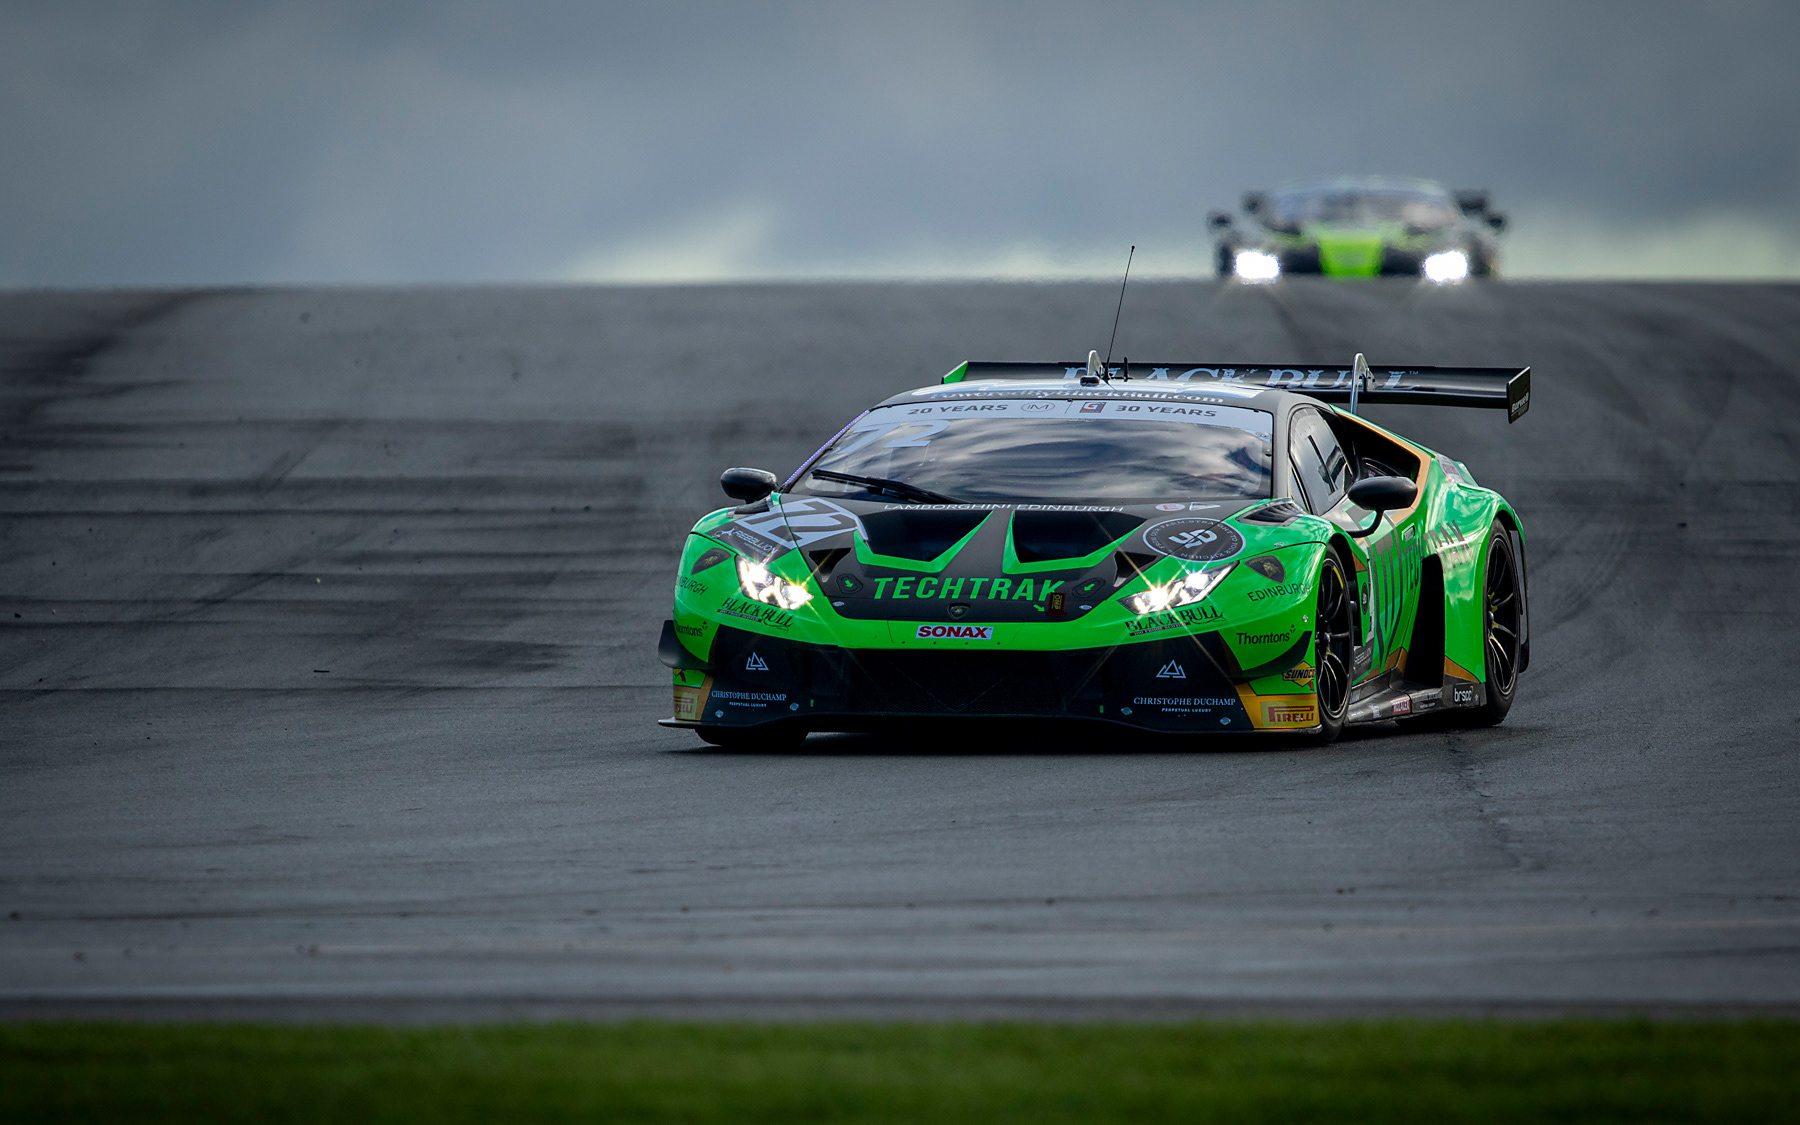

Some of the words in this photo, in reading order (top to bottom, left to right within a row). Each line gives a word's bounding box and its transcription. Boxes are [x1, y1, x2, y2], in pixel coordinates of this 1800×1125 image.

[907, 407, 933, 415] 20
[940, 404, 1008, 414] YEARS
[1147, 406, 1217, 417] YEARS
[836, 420, 951, 455] 72
[883, 503, 1011, 511] LAMBORGHINI
[1016, 503, 1125, 512] EDINBURGH
[874, 577, 1065, 601] TECHTRAK
[1247, 582, 1312, 602] EDINBURGH
[722, 597, 760, 617] BLACK
[761, 607, 794, 628] BULL
[1125, 612, 1180, 631] BLACK
[1179, 605, 1223, 624] BULL
[917, 625, 989, 638] SONAX
[1236, 631, 1290, 645] Thorntons
[711, 690, 750, 700] CHRISTOPHE
[751, 692, 787, 701] DUCHAMP
[1133, 697, 1192, 706] CHRISTOPHE
[1194, 698, 1236, 706] DUCHAMP
[1267, 705, 1314, 723] PIRELLI
